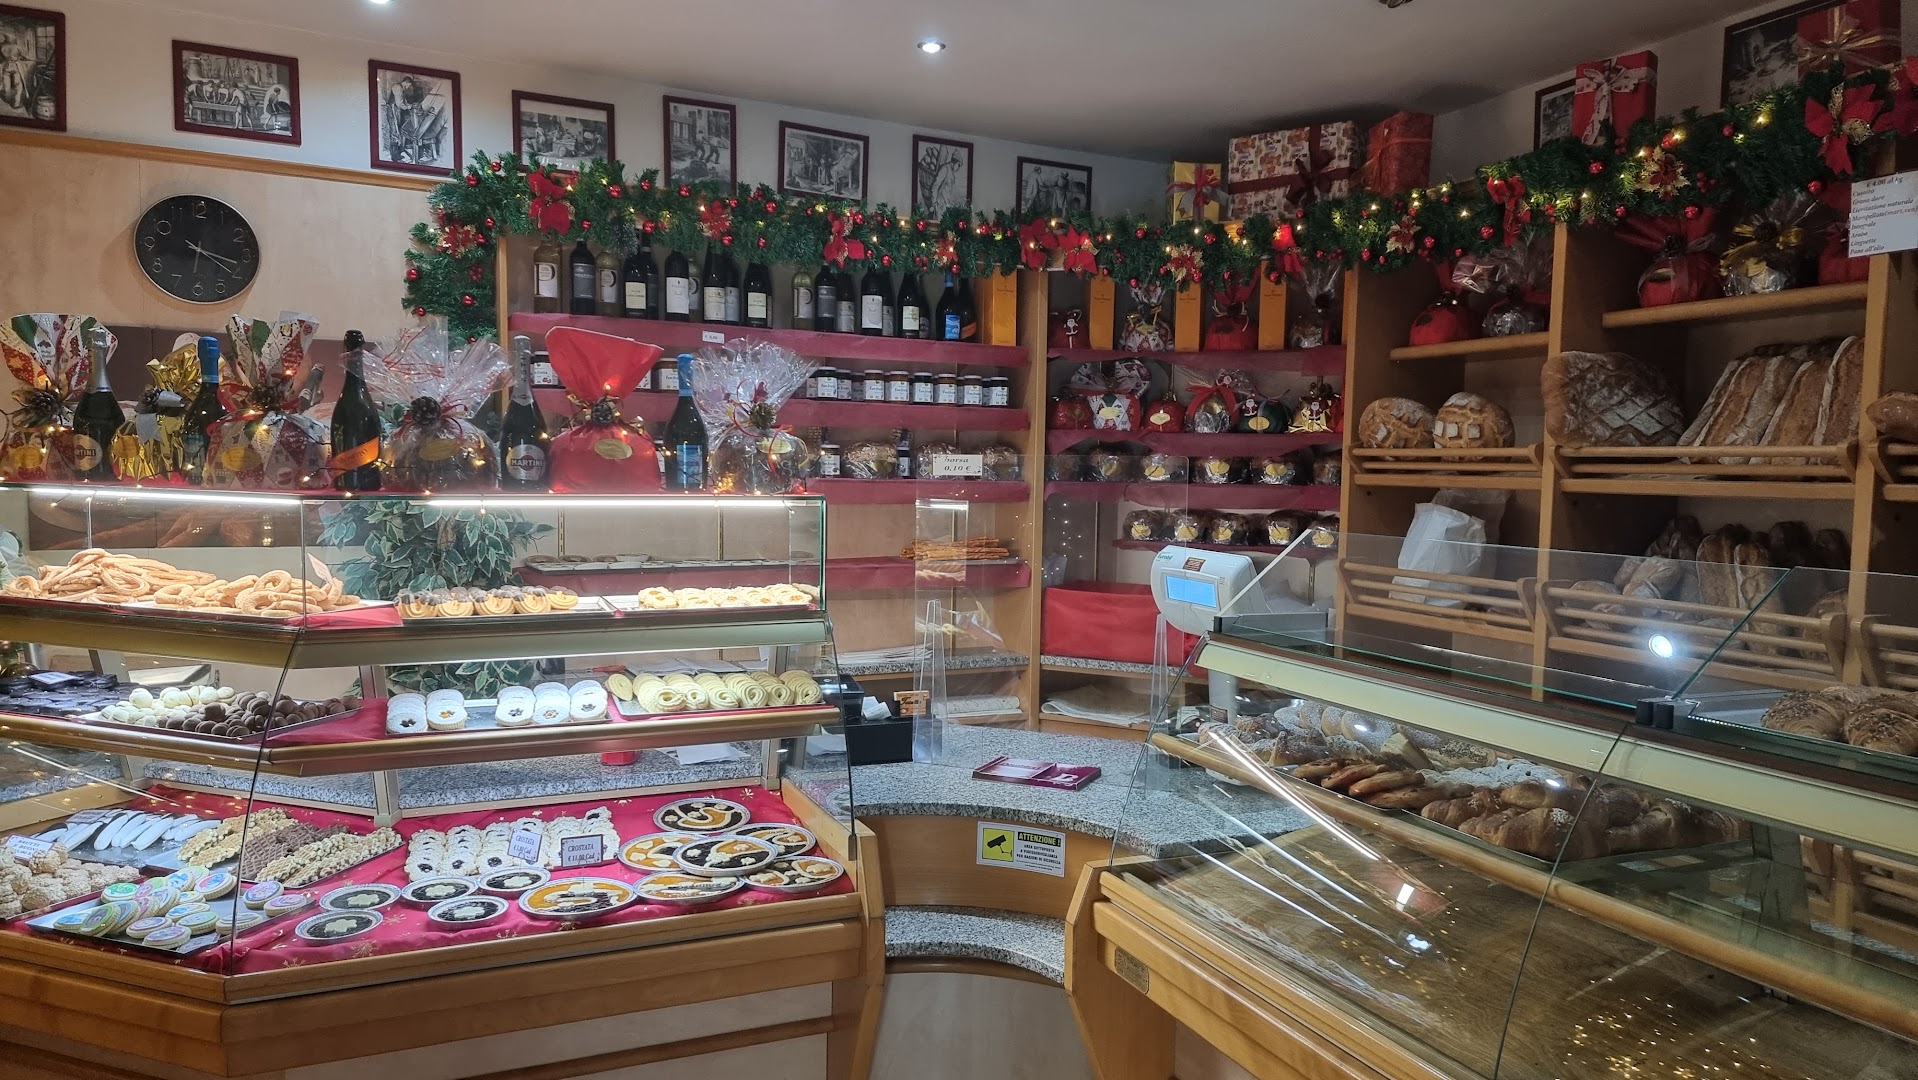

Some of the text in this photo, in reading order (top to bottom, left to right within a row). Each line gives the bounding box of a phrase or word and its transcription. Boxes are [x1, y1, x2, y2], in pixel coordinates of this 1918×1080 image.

[191, 203, 207, 219] 12
[1853, 198, 1914, 213] Lievitazione naturale
[1851, 221, 1877, 230] Integrale
[233, 227, 244, 243] 2
[1850, 238, 1877, 247] Linguette
[144, 236, 156, 251] 9
[242, 248, 252, 263] 3
[152, 257, 163, 273] 8
[171, 273, 182, 289] 7
[193, 281, 204, 296] 6
[215, 279, 226, 294] 5
[511, 458, 544, 467] MARTINI
[515, 834, 535, 846] CROSTATA
[1018, 832, 1057, 845] ATTENZIONE
[567, 843, 594, 852] CROSTATA
